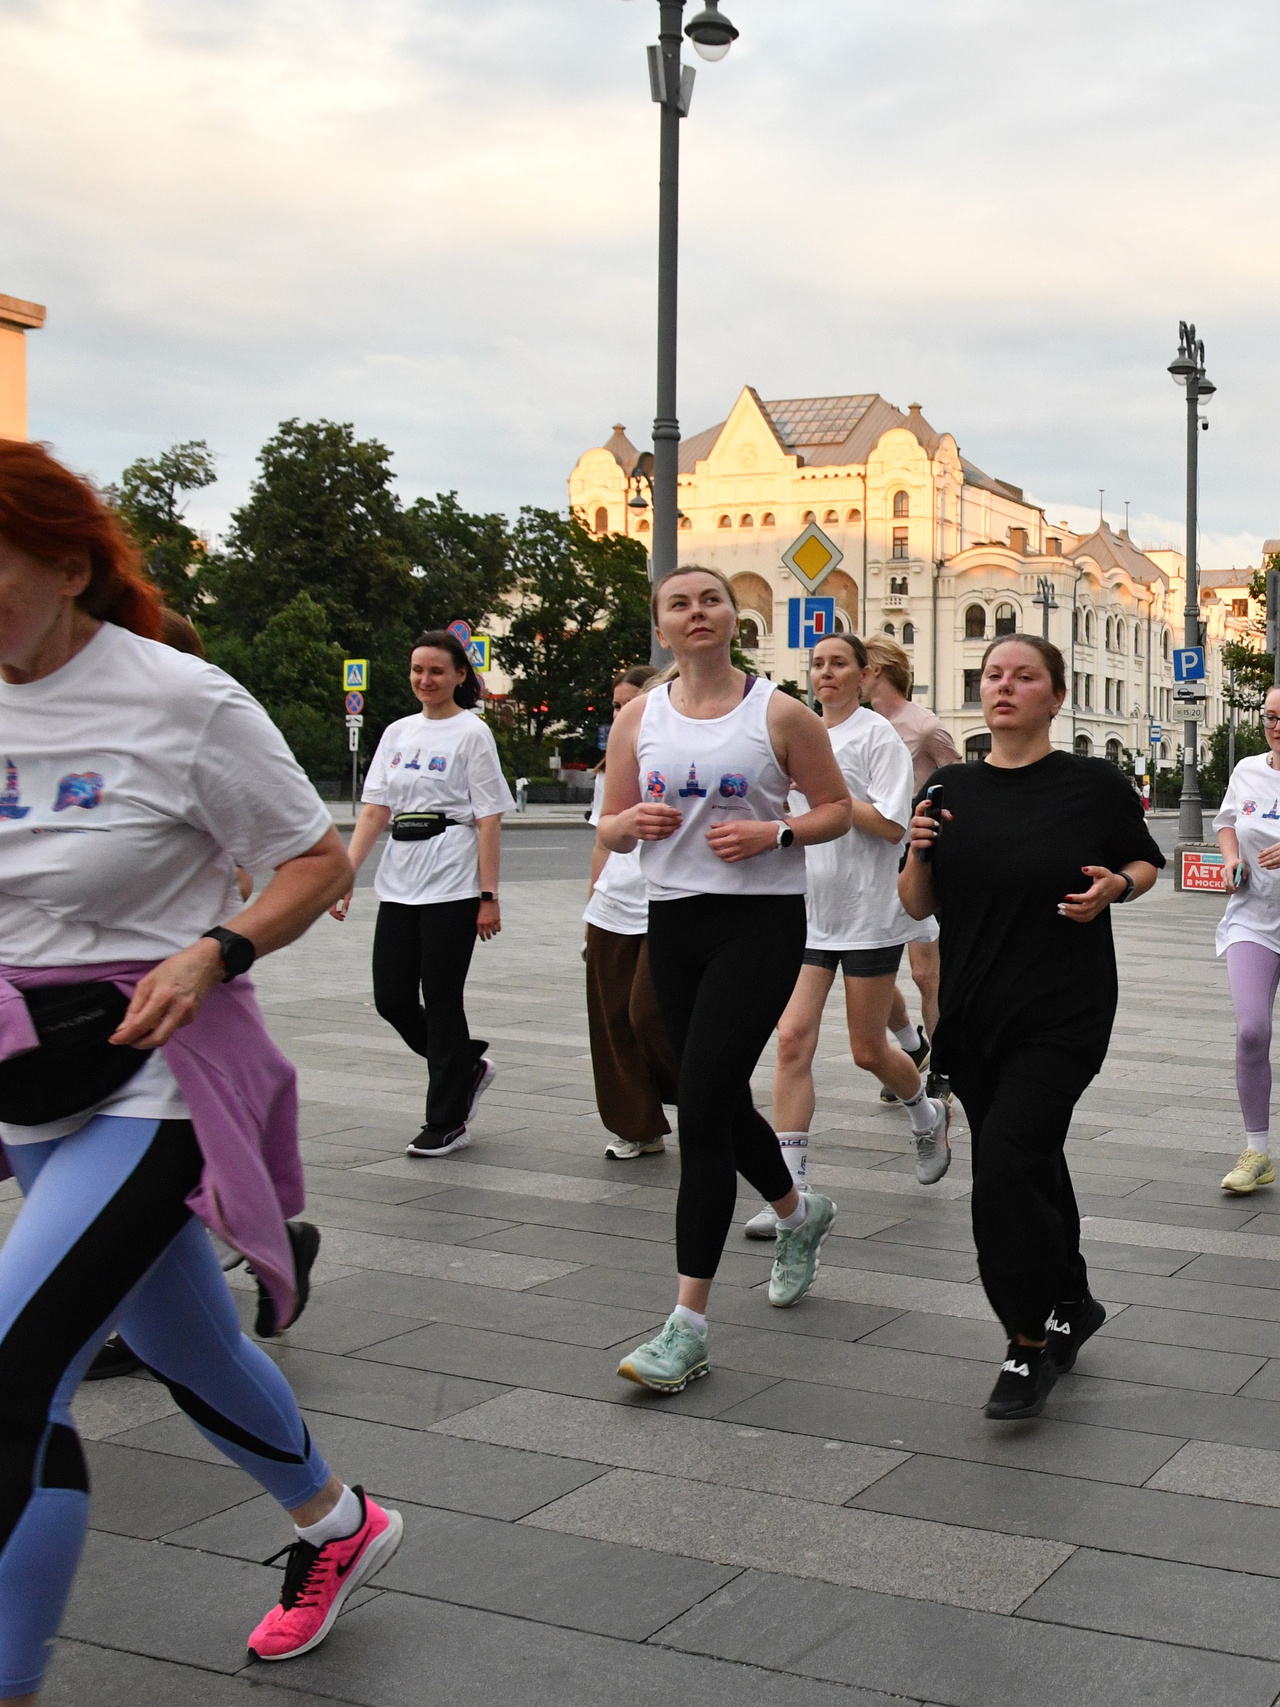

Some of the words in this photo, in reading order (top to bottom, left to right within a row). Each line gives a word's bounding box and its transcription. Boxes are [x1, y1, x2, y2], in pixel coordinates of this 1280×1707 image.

[1181, 651, 1199, 678] P
[1191, 709, 1201, 717] 20
[1195, 880, 1225, 888] МОСК
